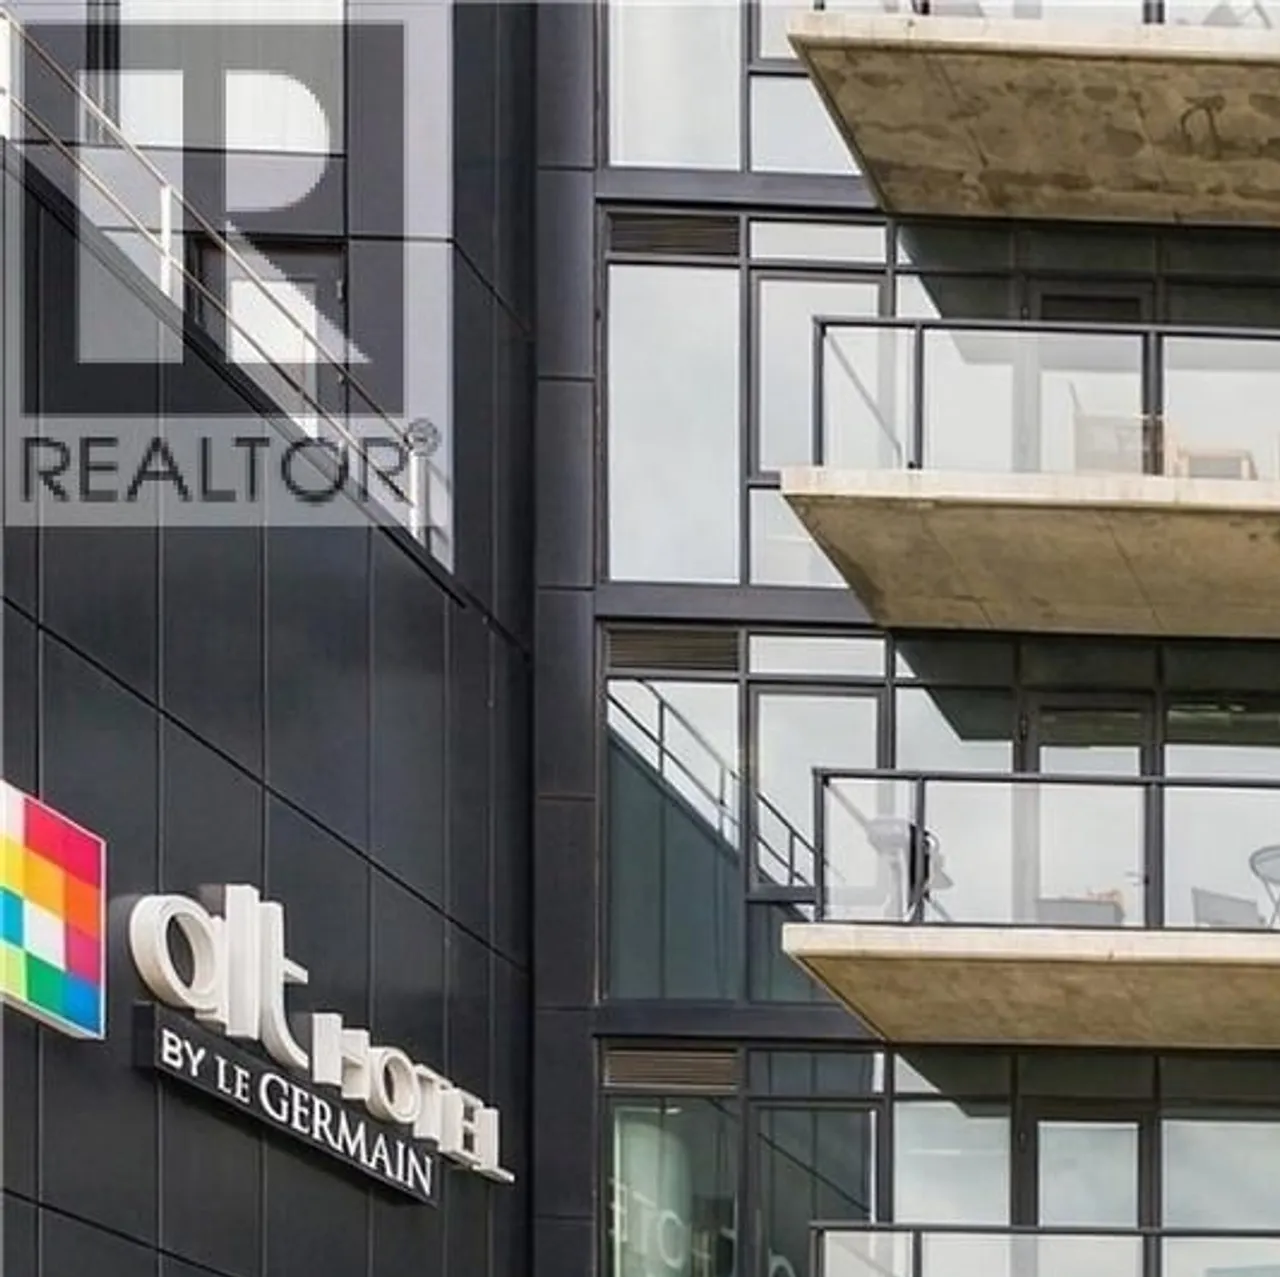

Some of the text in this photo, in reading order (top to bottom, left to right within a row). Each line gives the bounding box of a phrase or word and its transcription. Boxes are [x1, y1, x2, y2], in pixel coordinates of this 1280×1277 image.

[130, 884, 308, 1070] alt
[161, 1028, 434, 1197] BY LE GERMAIN
